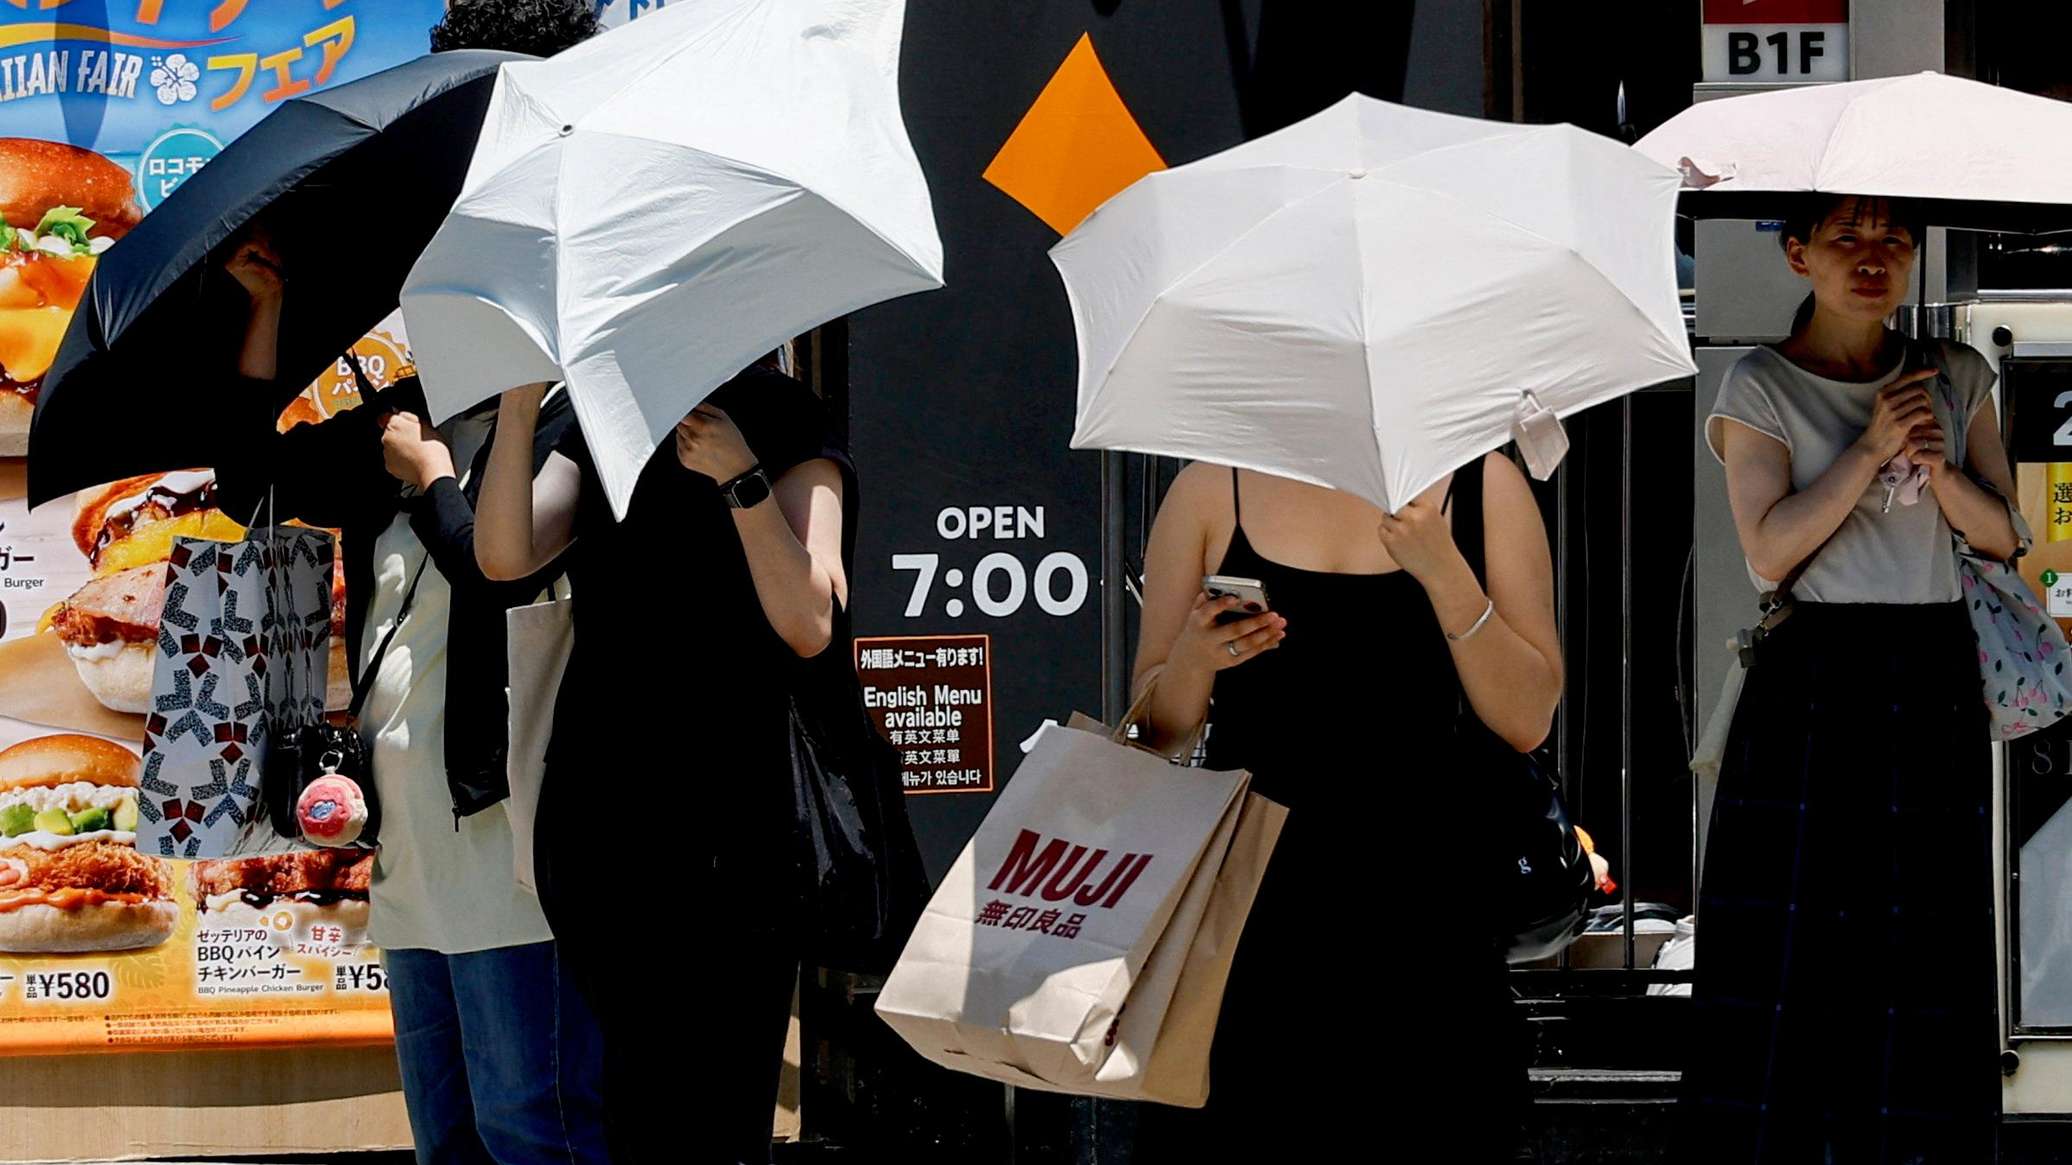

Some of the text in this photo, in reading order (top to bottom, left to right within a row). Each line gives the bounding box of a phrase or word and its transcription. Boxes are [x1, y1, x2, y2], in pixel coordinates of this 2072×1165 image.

[206, 15, 356, 112] フェア
[1728, 31, 1825, 75] B1F
[76, 50, 143, 98] FAIR
[149, 156, 212, 176] ロコモ
[936, 505, 1045, 540] OPEN
[4, 577, 44, 590] Burger
[892, 551, 1089, 618] 7:00
[860, 647, 984, 669] 外国語メニュー有ります!
[863, 684, 982, 708] English Menu
[885, 706, 962, 728] available
[889, 728, 960, 745] 有英文菜单
[901, 749, 961, 765] 英文菜單
[935, 768, 982, 785] 있습니다
[987, 828, 1154, 909] MUJI
[975, 899, 1088, 940] 無印良品
[197, 929, 268, 943] ゼッテリアの
[198, 963, 301, 982] チキンバーガー
[38, 971, 110, 999] ¥580
[198, 983, 324, 994] BBQ Pineapple Chicken Burger
